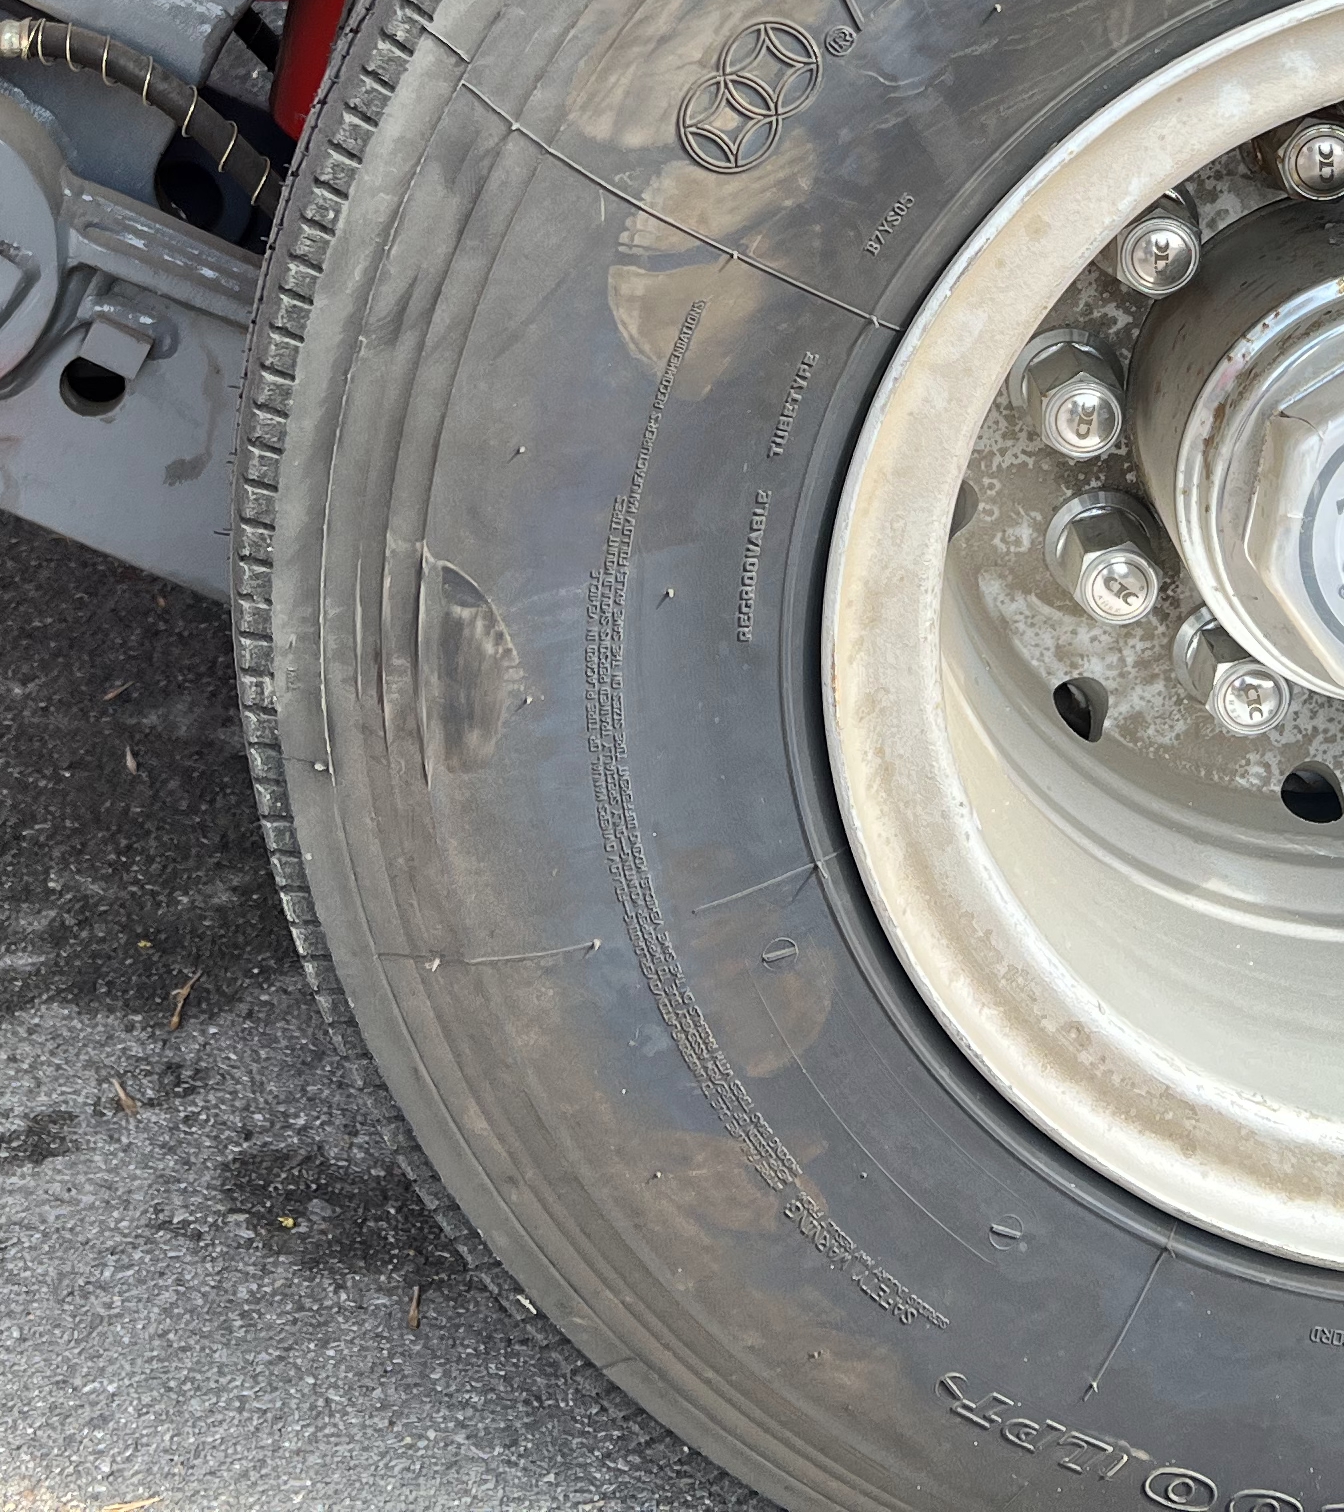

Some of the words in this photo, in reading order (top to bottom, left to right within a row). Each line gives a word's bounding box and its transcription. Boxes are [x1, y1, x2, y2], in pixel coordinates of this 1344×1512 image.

[862, 192, 916, 257] B7YS05
[652, 296, 707, 410] RECOMMENDATIONS
[737, 490, 773, 643] REGROOVABLE
[766, 350, 821, 459] TUBETYPE
[849, 1265, 918, 1325] SAFETY
